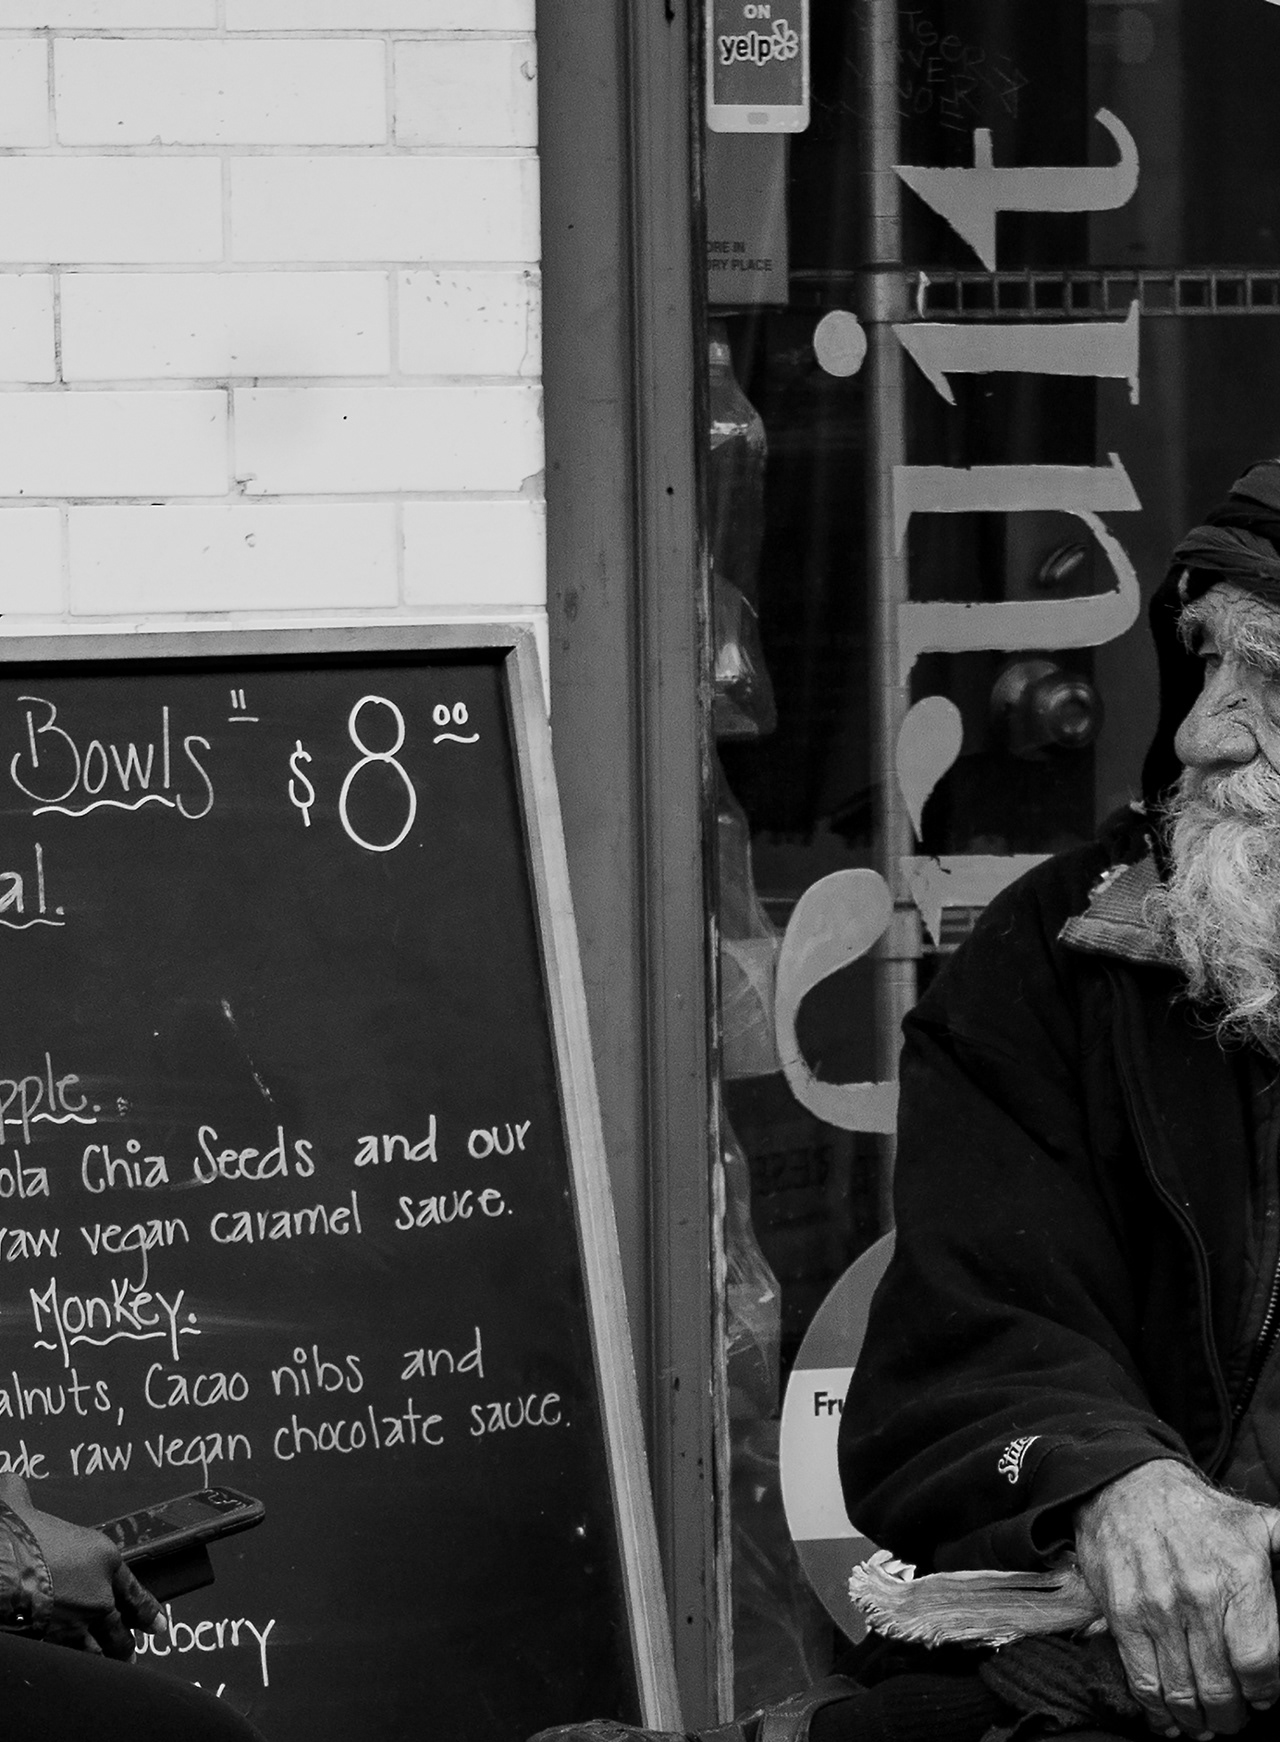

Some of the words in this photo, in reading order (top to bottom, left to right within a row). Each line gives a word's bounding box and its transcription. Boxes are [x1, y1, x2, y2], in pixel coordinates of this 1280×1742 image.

[718, 30, 773, 66] yelp
[743, 3, 771, 19] ON
[731, 259, 773, 271] PLACE
[83, 1144, 169, 1192] Chia
[195, 1126, 313, 1184] Seeds
[354, 1115, 437, 1166] and
[469, 1118, 531, 1160] our
[80, 1216, 189, 1286] vegan
[212, 1202, 361, 1243] caramel
[395, 1187, 514, 1230] sauce.
[31, 1277, 198, 1366] Monkey.
[144, 1365, 248, 1410] Cacao
[271, 1345, 364, 1396] nibs
[402, 1327, 485, 1382] and
[70, 1442, 132, 1477] raw
[146, 1429, 251, 1488] vegan
[273, 1408, 445, 1463] chocolate
[470, 1391, 573, 1436] sauce.
[130, 1603, 276, 1687] ueberry
